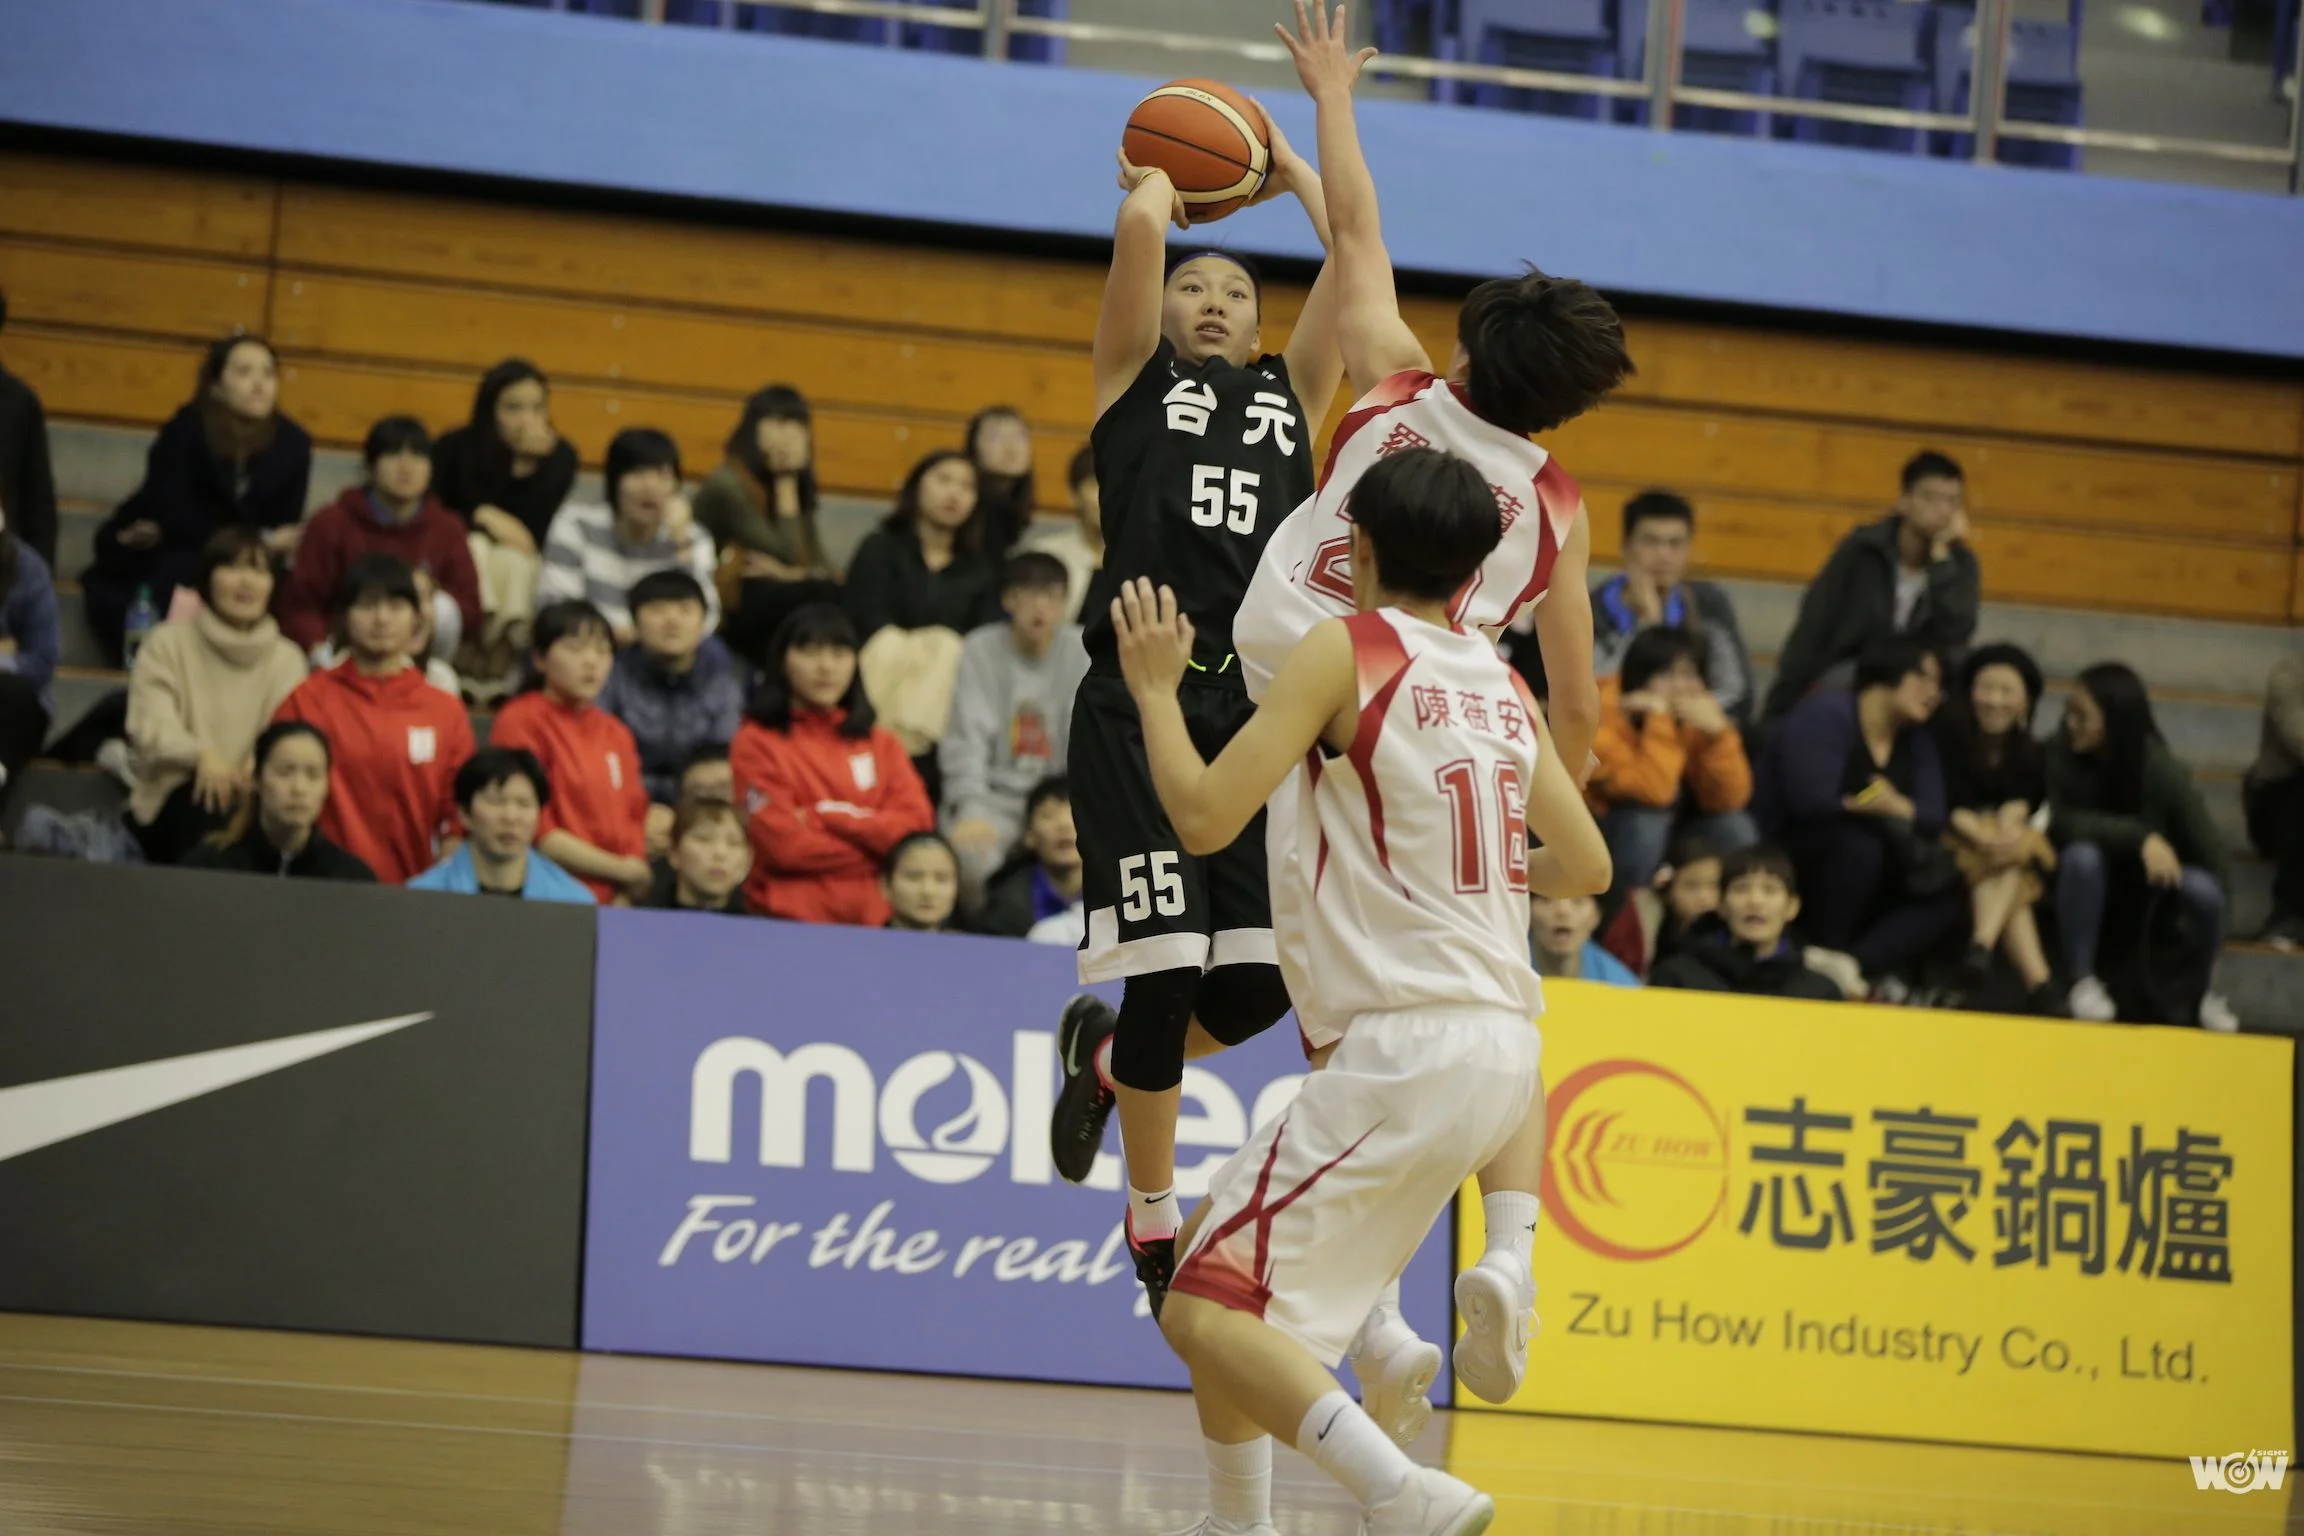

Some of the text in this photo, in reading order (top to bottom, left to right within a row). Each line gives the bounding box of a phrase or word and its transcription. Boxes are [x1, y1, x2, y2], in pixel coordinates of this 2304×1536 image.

[1162, 379, 1297, 457] 台元
[1191, 463, 1261, 536] 55
[1119, 850, 1186, 922] 55
[690, 1029, 1308, 1199] mole
[1738, 1096, 2234, 1285] 志豪鍋爐
[658, 1194, 1126, 1285] For the real
[1566, 1293, 2210, 1384] Zu How Industry Co., Ltd.
